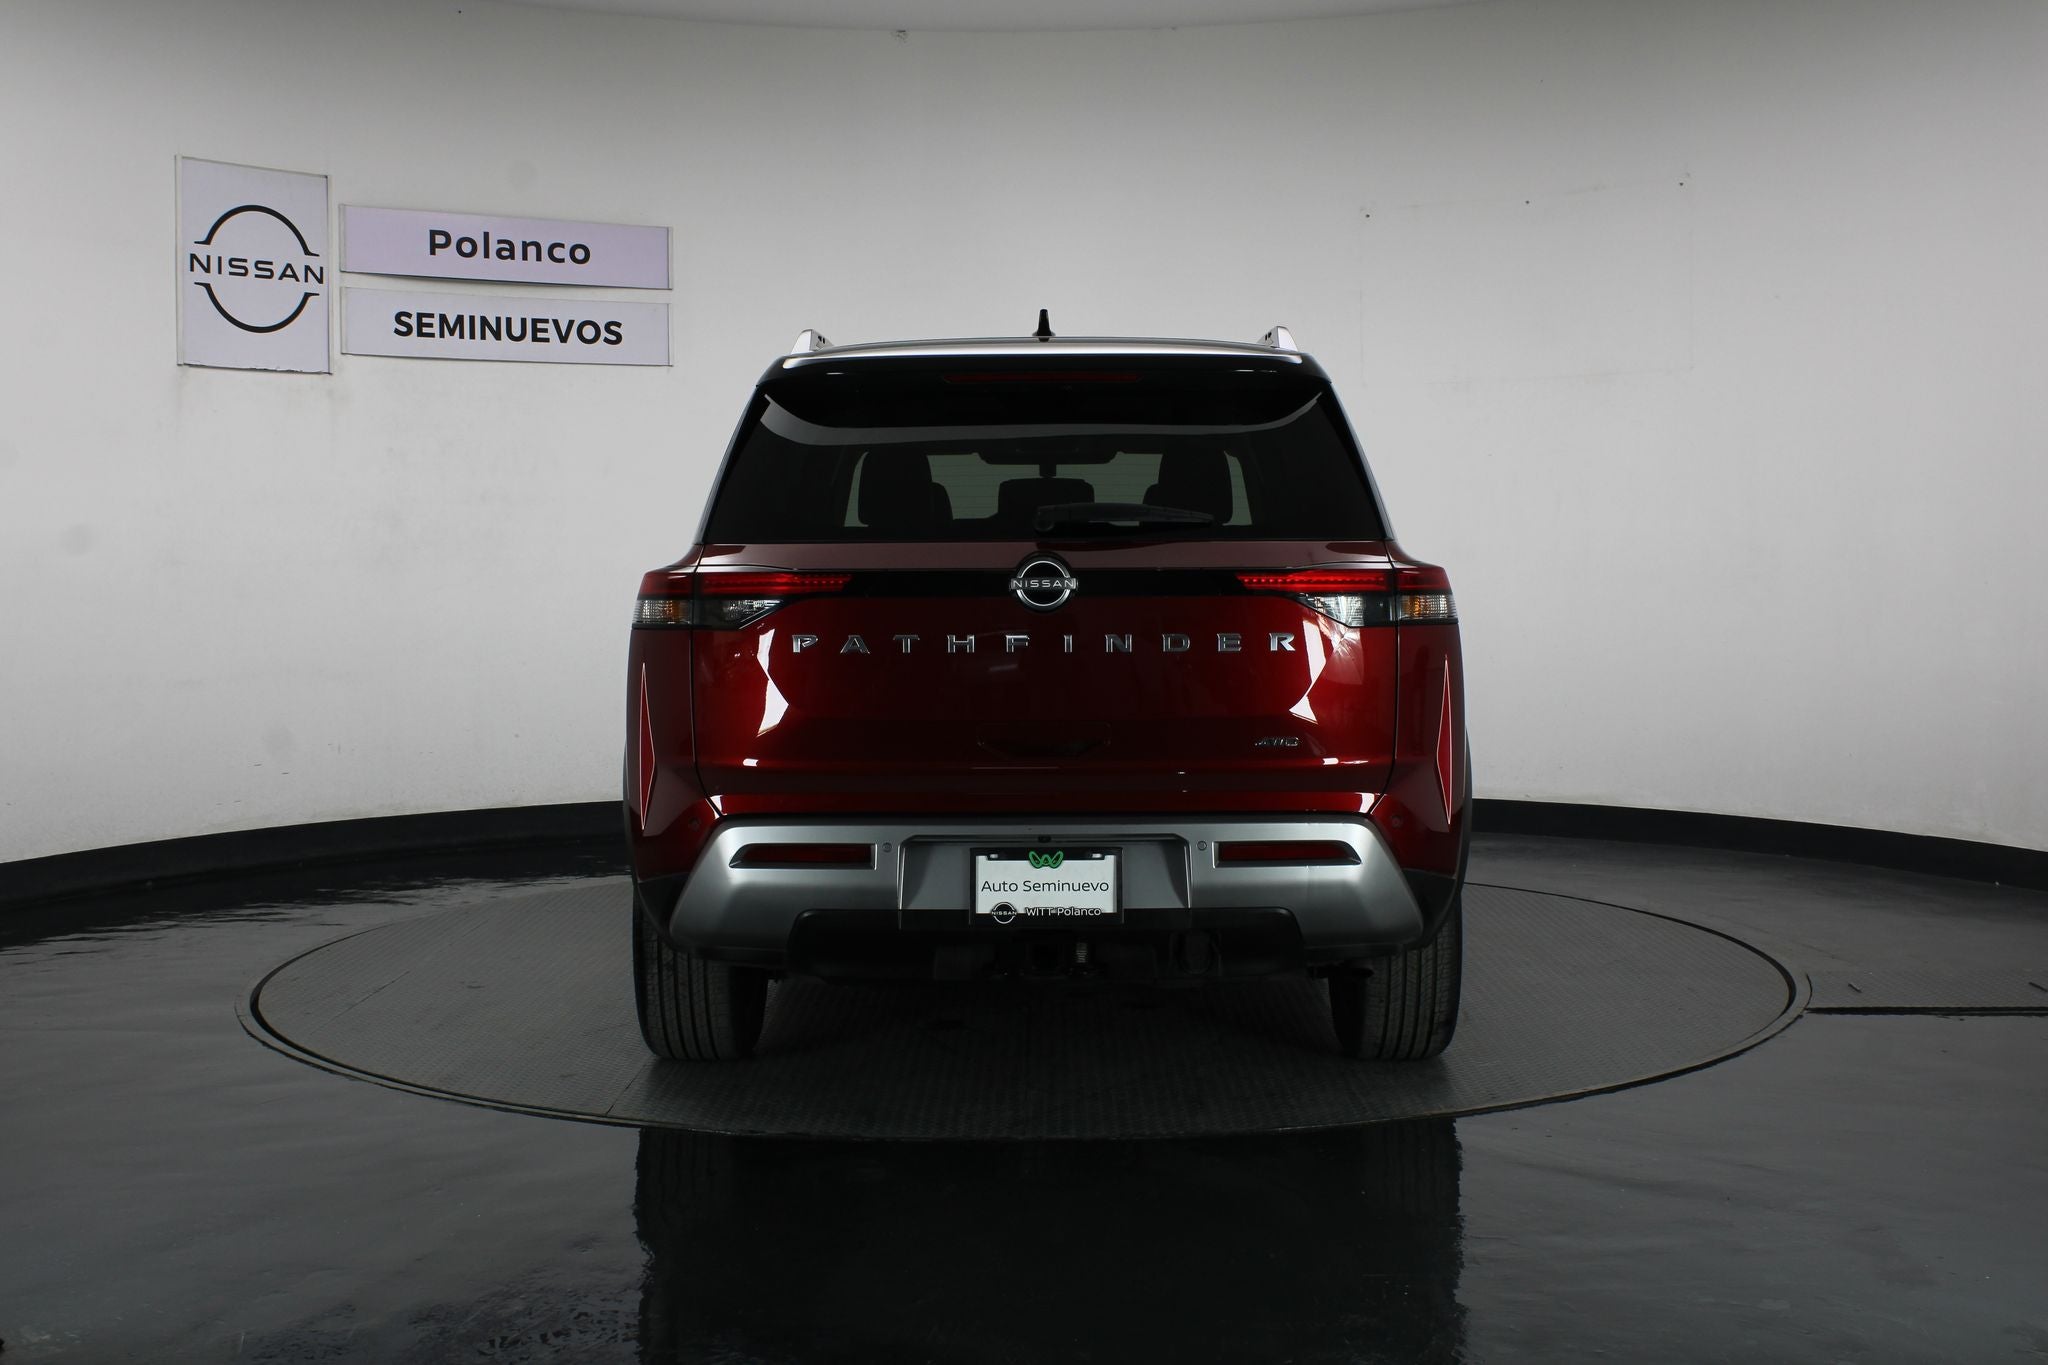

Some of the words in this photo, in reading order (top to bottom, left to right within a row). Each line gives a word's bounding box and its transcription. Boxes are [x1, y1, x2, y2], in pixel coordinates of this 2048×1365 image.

[429, 229, 592, 264] Polanco
[190, 253, 324, 284] NISSAN
[393, 311, 623, 346] SEMINUEVOS
[1011, 578, 1077, 589] NISSAN
[791, 633, 1296, 654] PATHFINDER
[981, 880, 1018, 892] Auto
[1023, 880, 1109, 892] Seminuevo
[1026, 907, 1053, 917] WITT
[1057, 907, 1101, 917] Polanco
